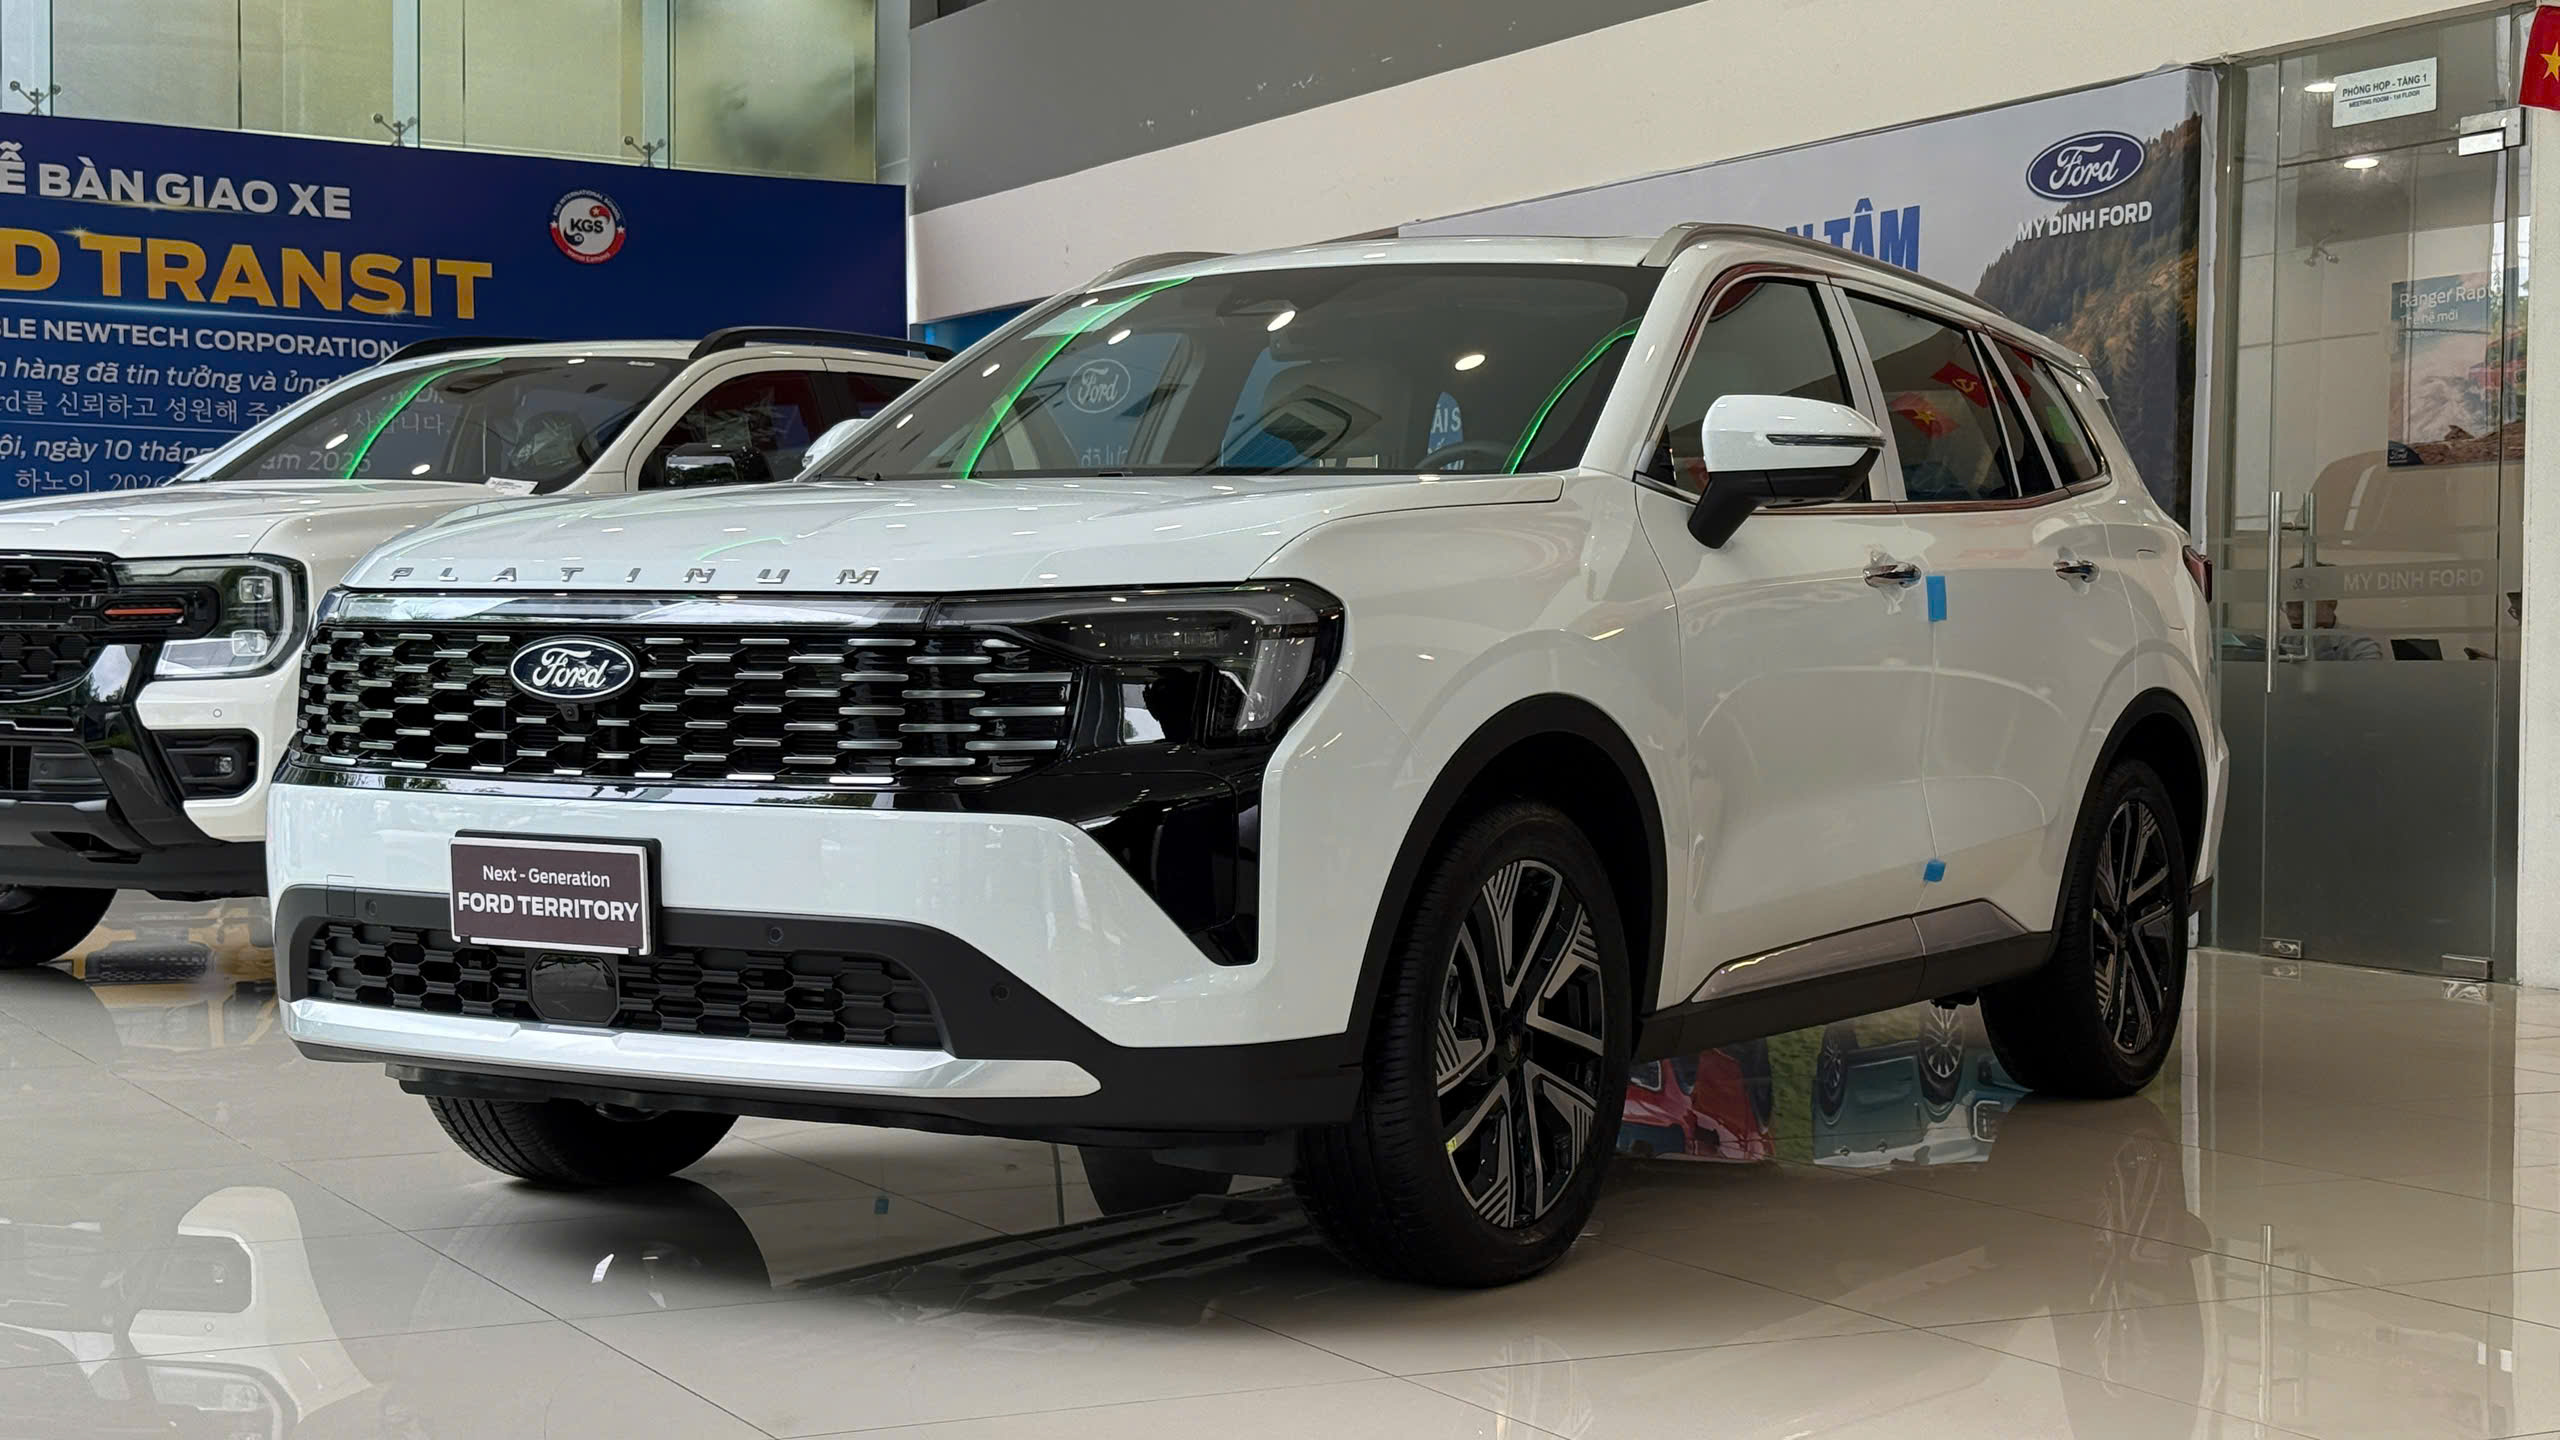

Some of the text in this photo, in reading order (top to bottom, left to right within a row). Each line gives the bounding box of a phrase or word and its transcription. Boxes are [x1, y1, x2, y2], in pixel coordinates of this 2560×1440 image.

[2342, 84, 2371, 98] PHÒNG
[2373, 80, 2391, 92] HỌP
[2423, 73, 2427, 82] 1
[2349, 98, 2371, 108] MEETING
[2373, 96, 2389, 104] ROOM
[2402, 90, 2420, 98] FLOOR
[2049, 143, 2121, 190] Ford
[39, 156, 145, 203] BÀN
[156, 174, 278, 213] GIAO
[289, 183, 351, 219] XE
[570, 217, 604, 234] KGS
[1824, 198, 1921, 273] TÂM
[2017, 201, 2152, 241] MY DINH FORD
[79, 232, 493, 320] TRANSIT
[2400, 287, 2454, 309] Ranger
[44, 319, 189, 349] NEWTECH
[14, 357, 80, 386] hàng
[87, 362, 119, 384] đã
[127, 366, 159, 386] tin
[167, 366, 243, 394] tưởng
[249, 371, 277, 392] và
[1079, 368, 1119, 405] Ford
[57, 391, 158, 419] 신뢰하고
[166, 396, 238, 424] 성원해
[34, 437, 98, 463] ngày
[104, 439, 132, 460] 10
[141, 440, 214, 463] thán
[389, 567, 880, 584] PLATINUM
[2344, 568, 2484, 591] MY DINH FORD
[533, 647, 609, 689] Ford
[483, 865, 517, 882] Next
[528, 868, 610, 888] Generation
[458, 891, 639, 922] FORD TERRITORY
